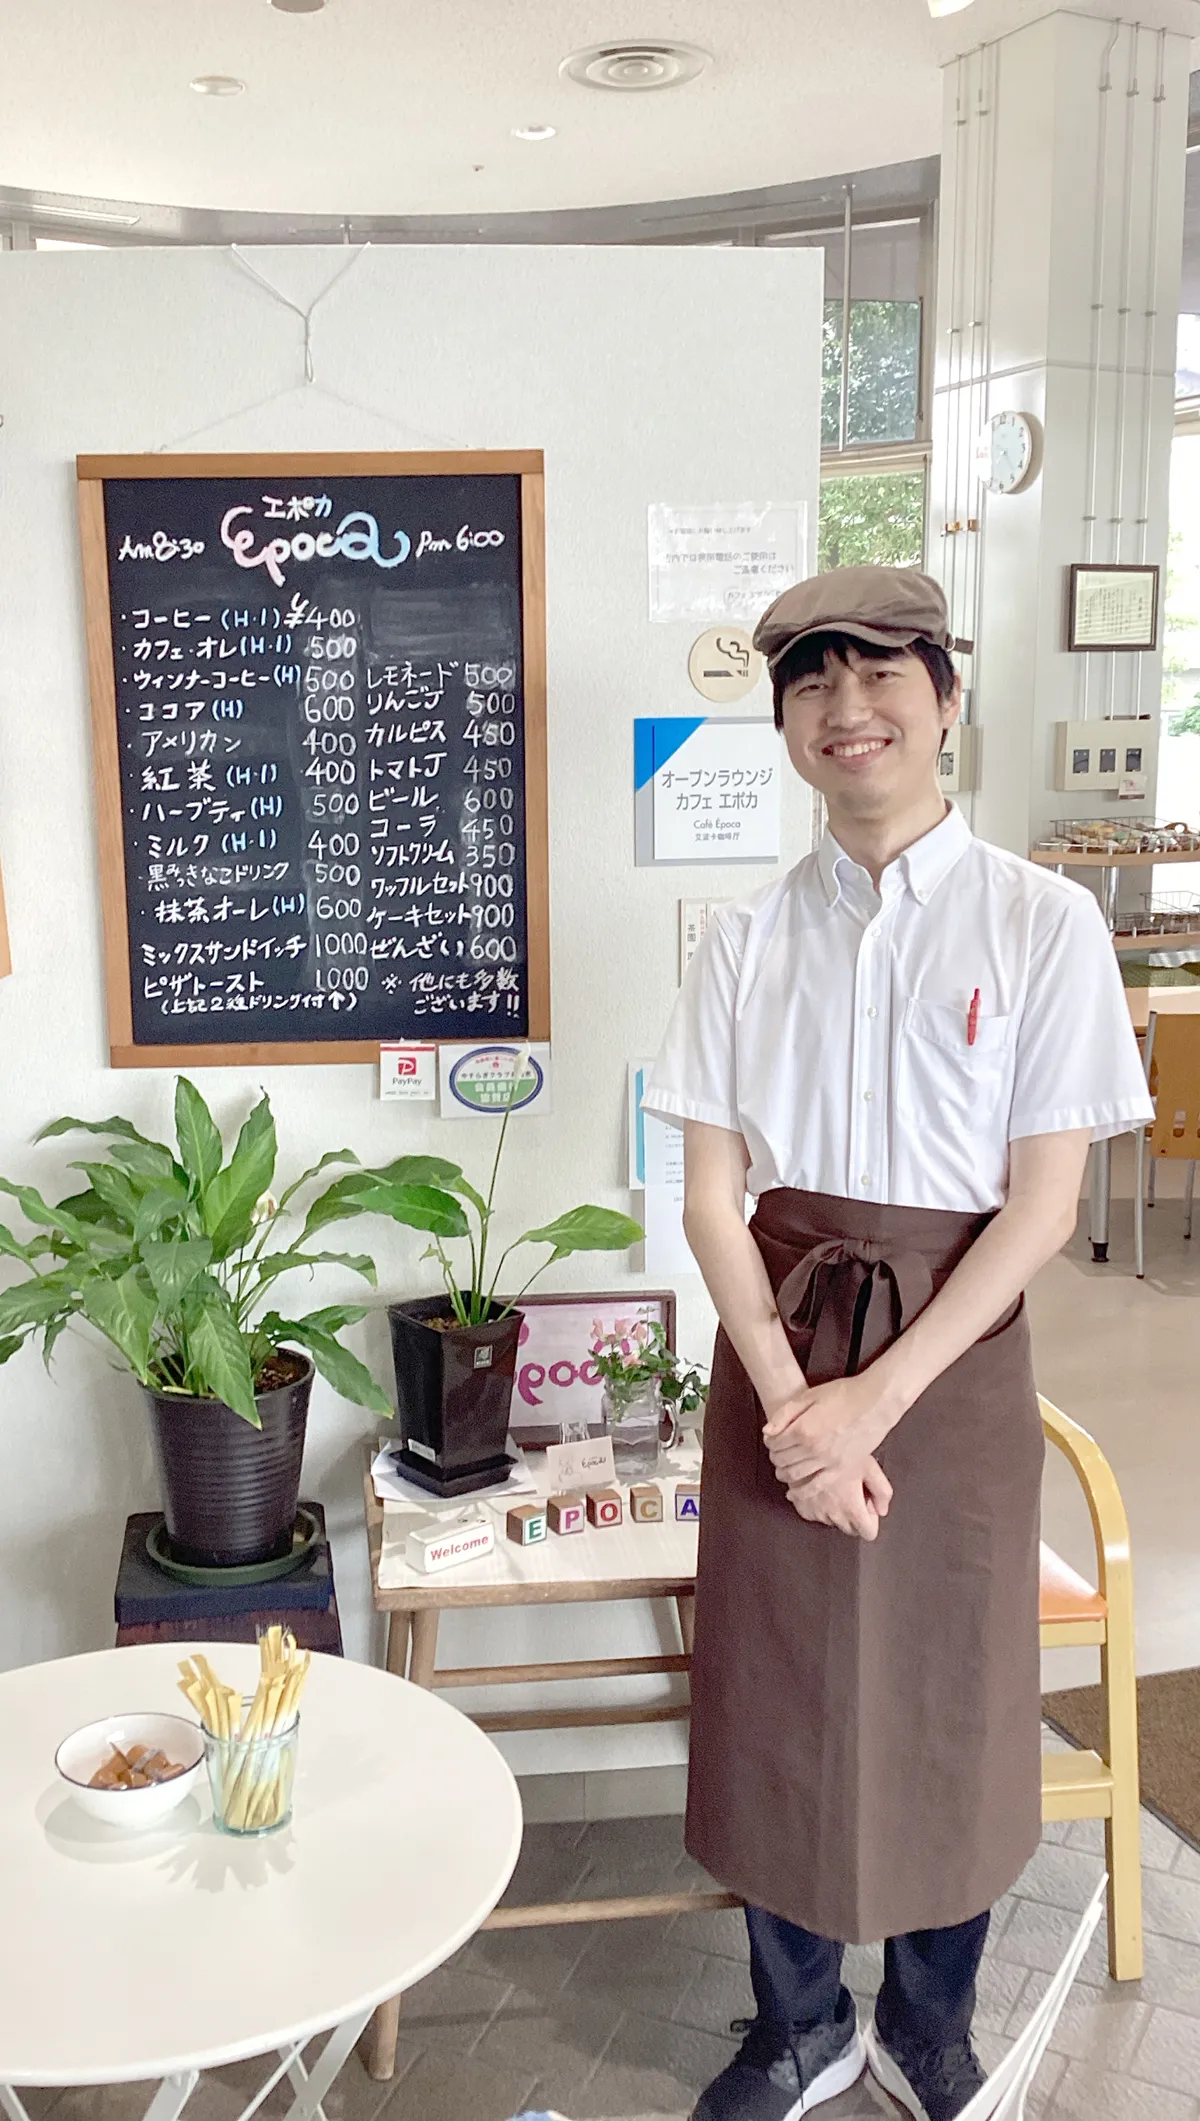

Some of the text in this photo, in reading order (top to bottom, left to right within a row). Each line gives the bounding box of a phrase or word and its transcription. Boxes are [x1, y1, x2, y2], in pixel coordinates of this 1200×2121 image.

[262, 494, 332, 521] エポカ
[131, 608, 211, 629] コーヒー
[309, 635, 358, 660] 500
[305, 665, 355, 692] 500
[367, 661, 513, 689] レモネード 500
[139, 694, 355, 723] ココア (H) 600
[466, 691, 516, 717] 500
[141, 727, 357, 757] アメリカン 400
[365, 719, 516, 748] カルピス 450
[304, 756, 356, 785] 400
[370, 752, 512, 783] トマトJ 450
[661, 767, 774, 789] オープンラウンジ
[250, 795, 284, 820] (H)
[312, 792, 360, 816] 500
[368, 785, 514, 813] ビール 600
[676, 791, 759, 811] カフェ エポカ
[370, 814, 514, 843] コーラ 450
[147, 834, 210, 859] ミルク
[308, 829, 360, 860] 400
[465, 842, 516, 869] 350
[314, 863, 361, 887] 500
[371, 871, 514, 899] ワッフルセット 900
[154, 892, 362, 924] 抹茶オーレ (H) 600
[365, 902, 515, 930] ケーキセット 900
[141, 932, 368, 967] ミックスサンドイッチ 1000
[369, 931, 517, 962] ぜんざい 600
[144, 966, 369, 999] ピザトースト 1000
[409, 966, 520, 993] 他にも多数
[392, 1077, 423, 1088] PayPay
[429, 1533, 489, 1562] Welcome
